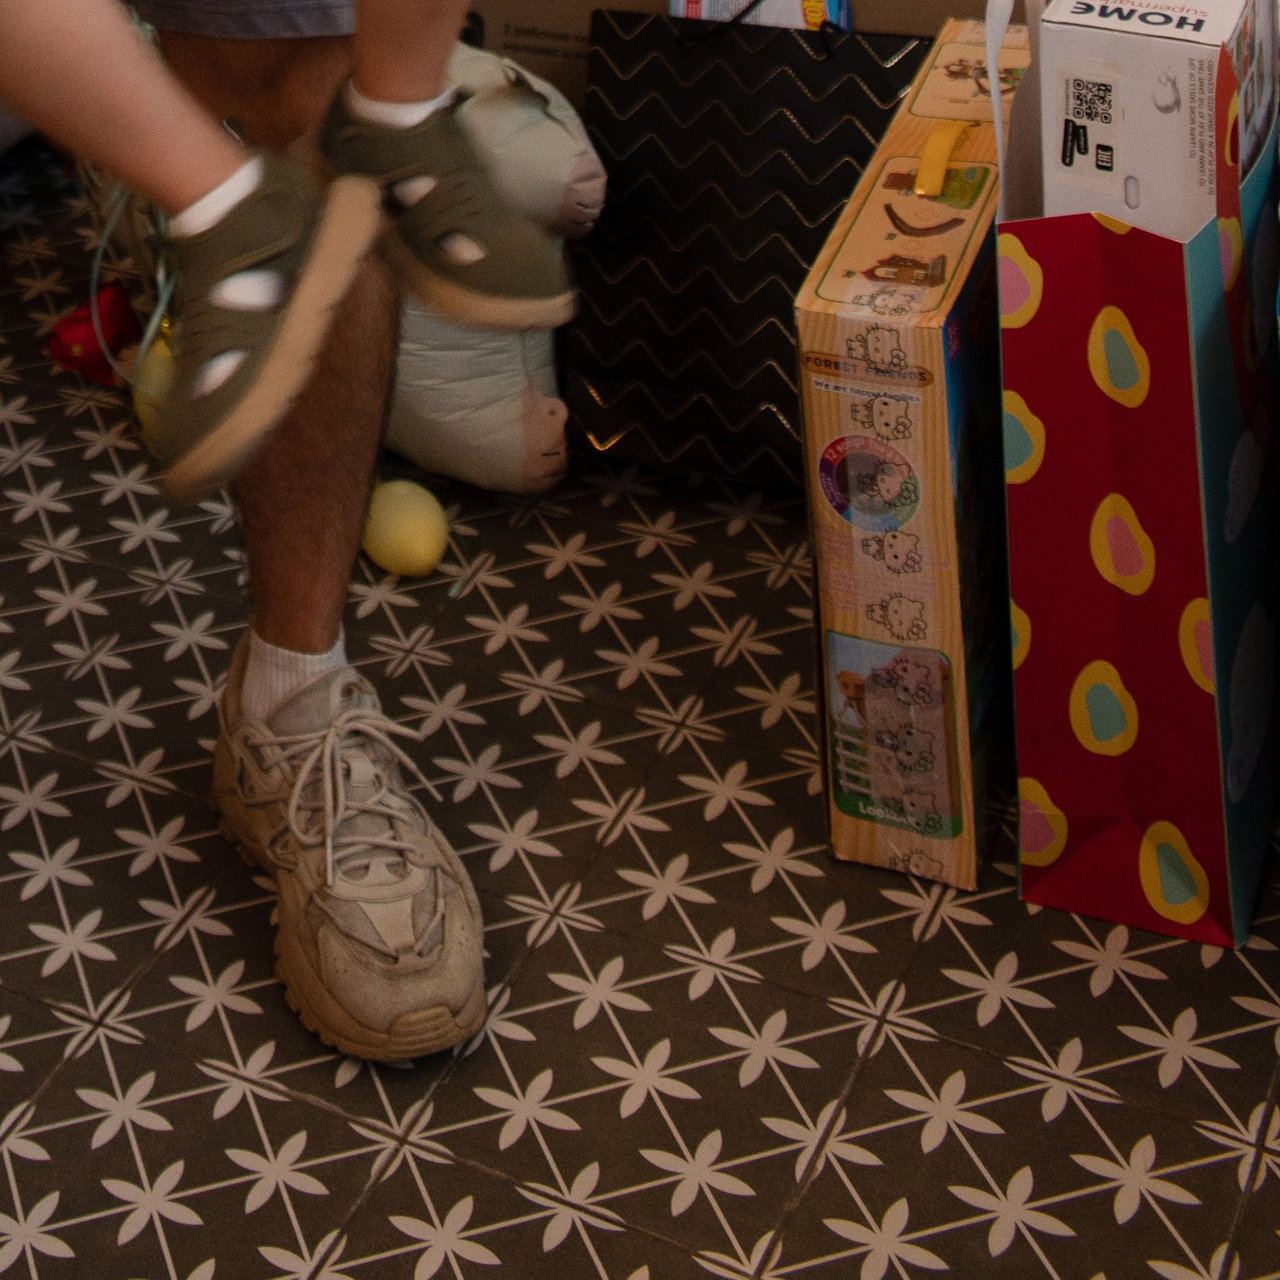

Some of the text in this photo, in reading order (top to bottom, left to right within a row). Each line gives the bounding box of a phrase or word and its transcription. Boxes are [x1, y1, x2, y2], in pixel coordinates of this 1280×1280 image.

[1070, 1, 1206, 32] HOME
[1188, 57, 1196, 71] LIFE
[1198, 59, 1206, 75] TIME
[1198, 77, 1206, 95] SAME
[1207, 60, 1215, 94] SCENARIO
[1188, 83, 1196, 104] SKILLS
[1198, 97, 1206, 109] THE
[1189, 106, 1197, 125] MORE
[1199, 111, 1206, 120] AT
[1207, 95, 1215, 133] SIMULATED
[1189, 127, 1197, 148] LEARN
[1199, 121, 1207, 137] PLAY
[1199, 138, 1207, 154] AND
[1199, 155, 1207, 177] LEARN
[805, 356, 858, 373] FOREST
